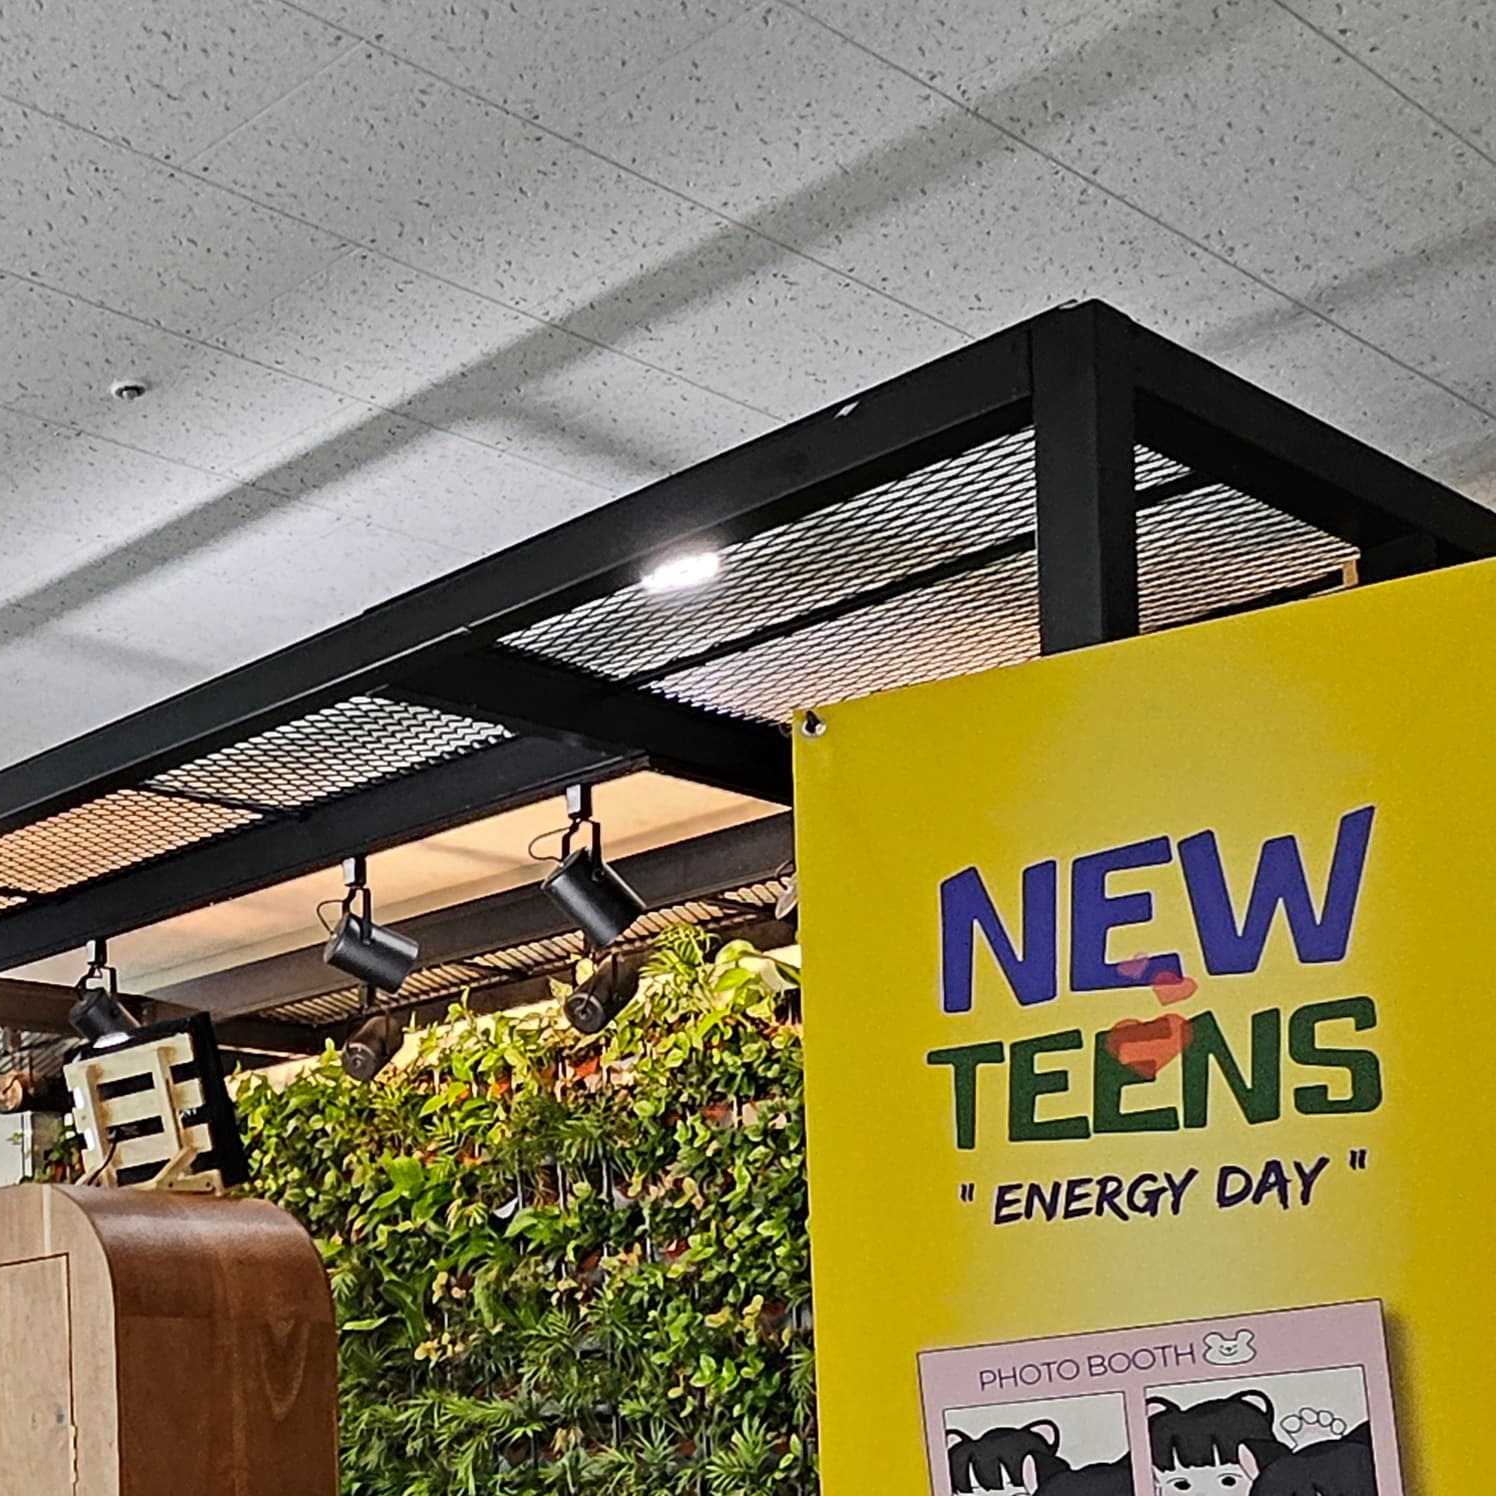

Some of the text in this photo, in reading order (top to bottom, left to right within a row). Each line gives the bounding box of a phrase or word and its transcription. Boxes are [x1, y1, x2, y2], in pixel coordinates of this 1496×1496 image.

[940, 805, 1376, 1013] NEW
[927, 996, 1383, 1149] TEENS
[993, 1167, 1198, 1225] ENERGY
[1216, 1156, 1329, 1210] DAY
[979, 1342, 1196, 1391] PHOTO BOOTH
